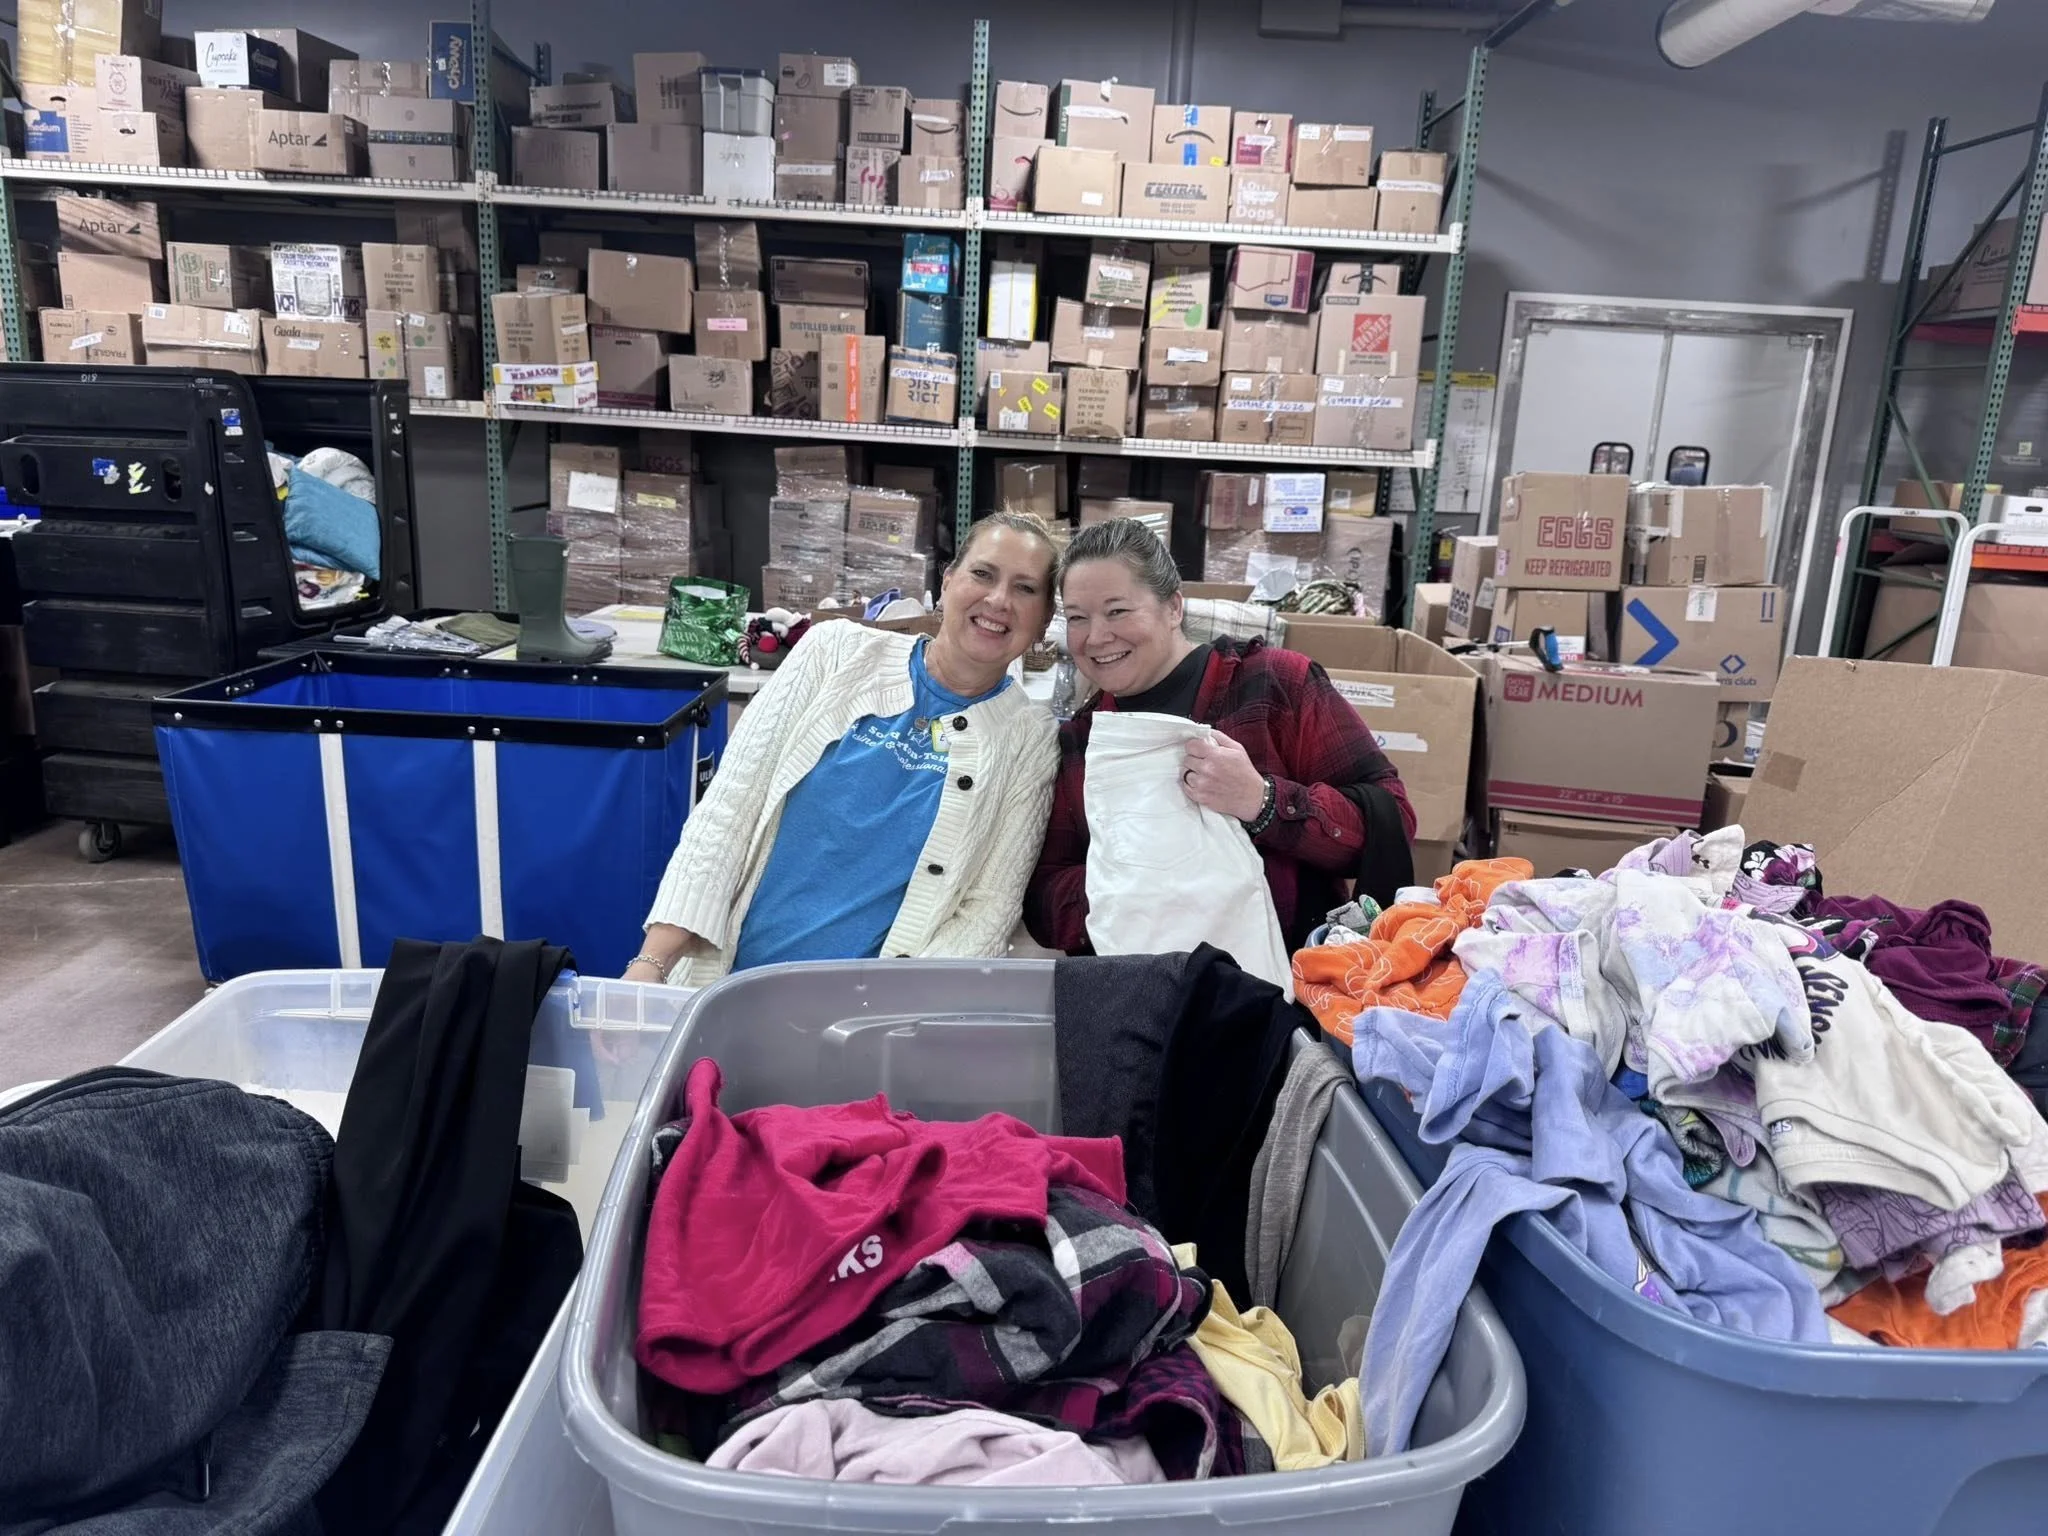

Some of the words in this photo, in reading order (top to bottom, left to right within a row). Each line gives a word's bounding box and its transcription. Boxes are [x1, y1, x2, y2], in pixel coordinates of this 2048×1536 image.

[449, 35, 464, 89] chewy
[268, 130, 311, 147] Aptar
[1237, 206, 1275, 220] Dogs
[79, 219, 124, 236] Aptar
[276, 293, 295, 312] VCR
[790, 322, 828, 331] DISTILLED
[830, 324, 856, 334] WATER
[1353, 315, 1389, 351] HOME
[1367, 327, 1390, 352] DEPOT
[1231, 400, 1273, 409] SUMMER
[1327, 397, 1364, 405] SUMMER
[1537, 515, 1614, 549] EGGS
[1524, 558, 1548, 576] KEEP
[1549, 559, 1612, 577] REFRIGERATED
[1734, 676, 1757, 686] club
[1537, 681, 1644, 708] MEDIUM
[828, 1234, 883, 1283] KS
